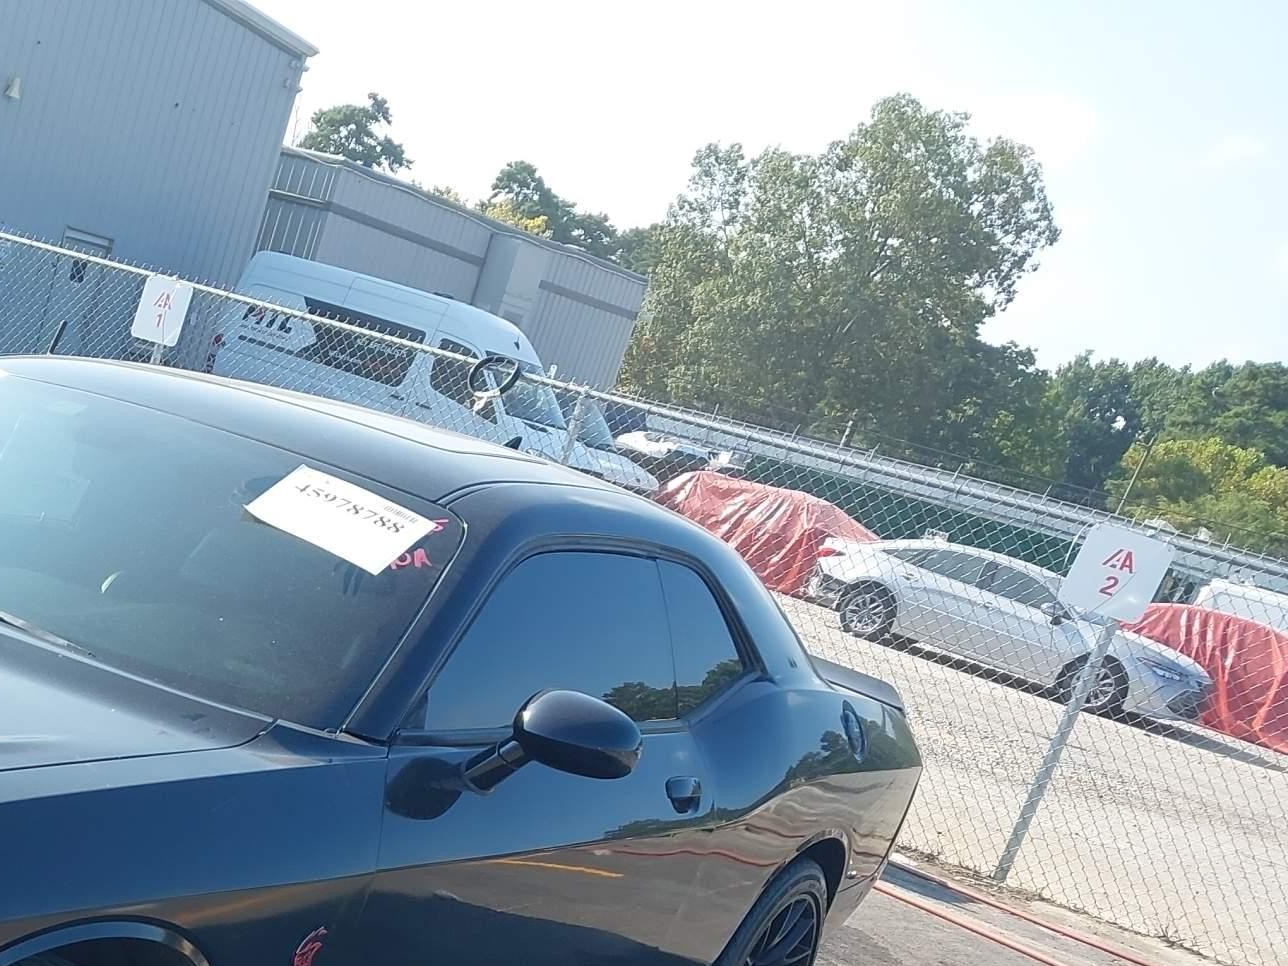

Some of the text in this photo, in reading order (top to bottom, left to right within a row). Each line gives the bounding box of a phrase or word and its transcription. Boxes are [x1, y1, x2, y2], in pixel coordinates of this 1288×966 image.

[156, 313, 163, 328] 1
[294, 484, 405, 534] 45978788
[1098, 575, 1120, 597] 2
